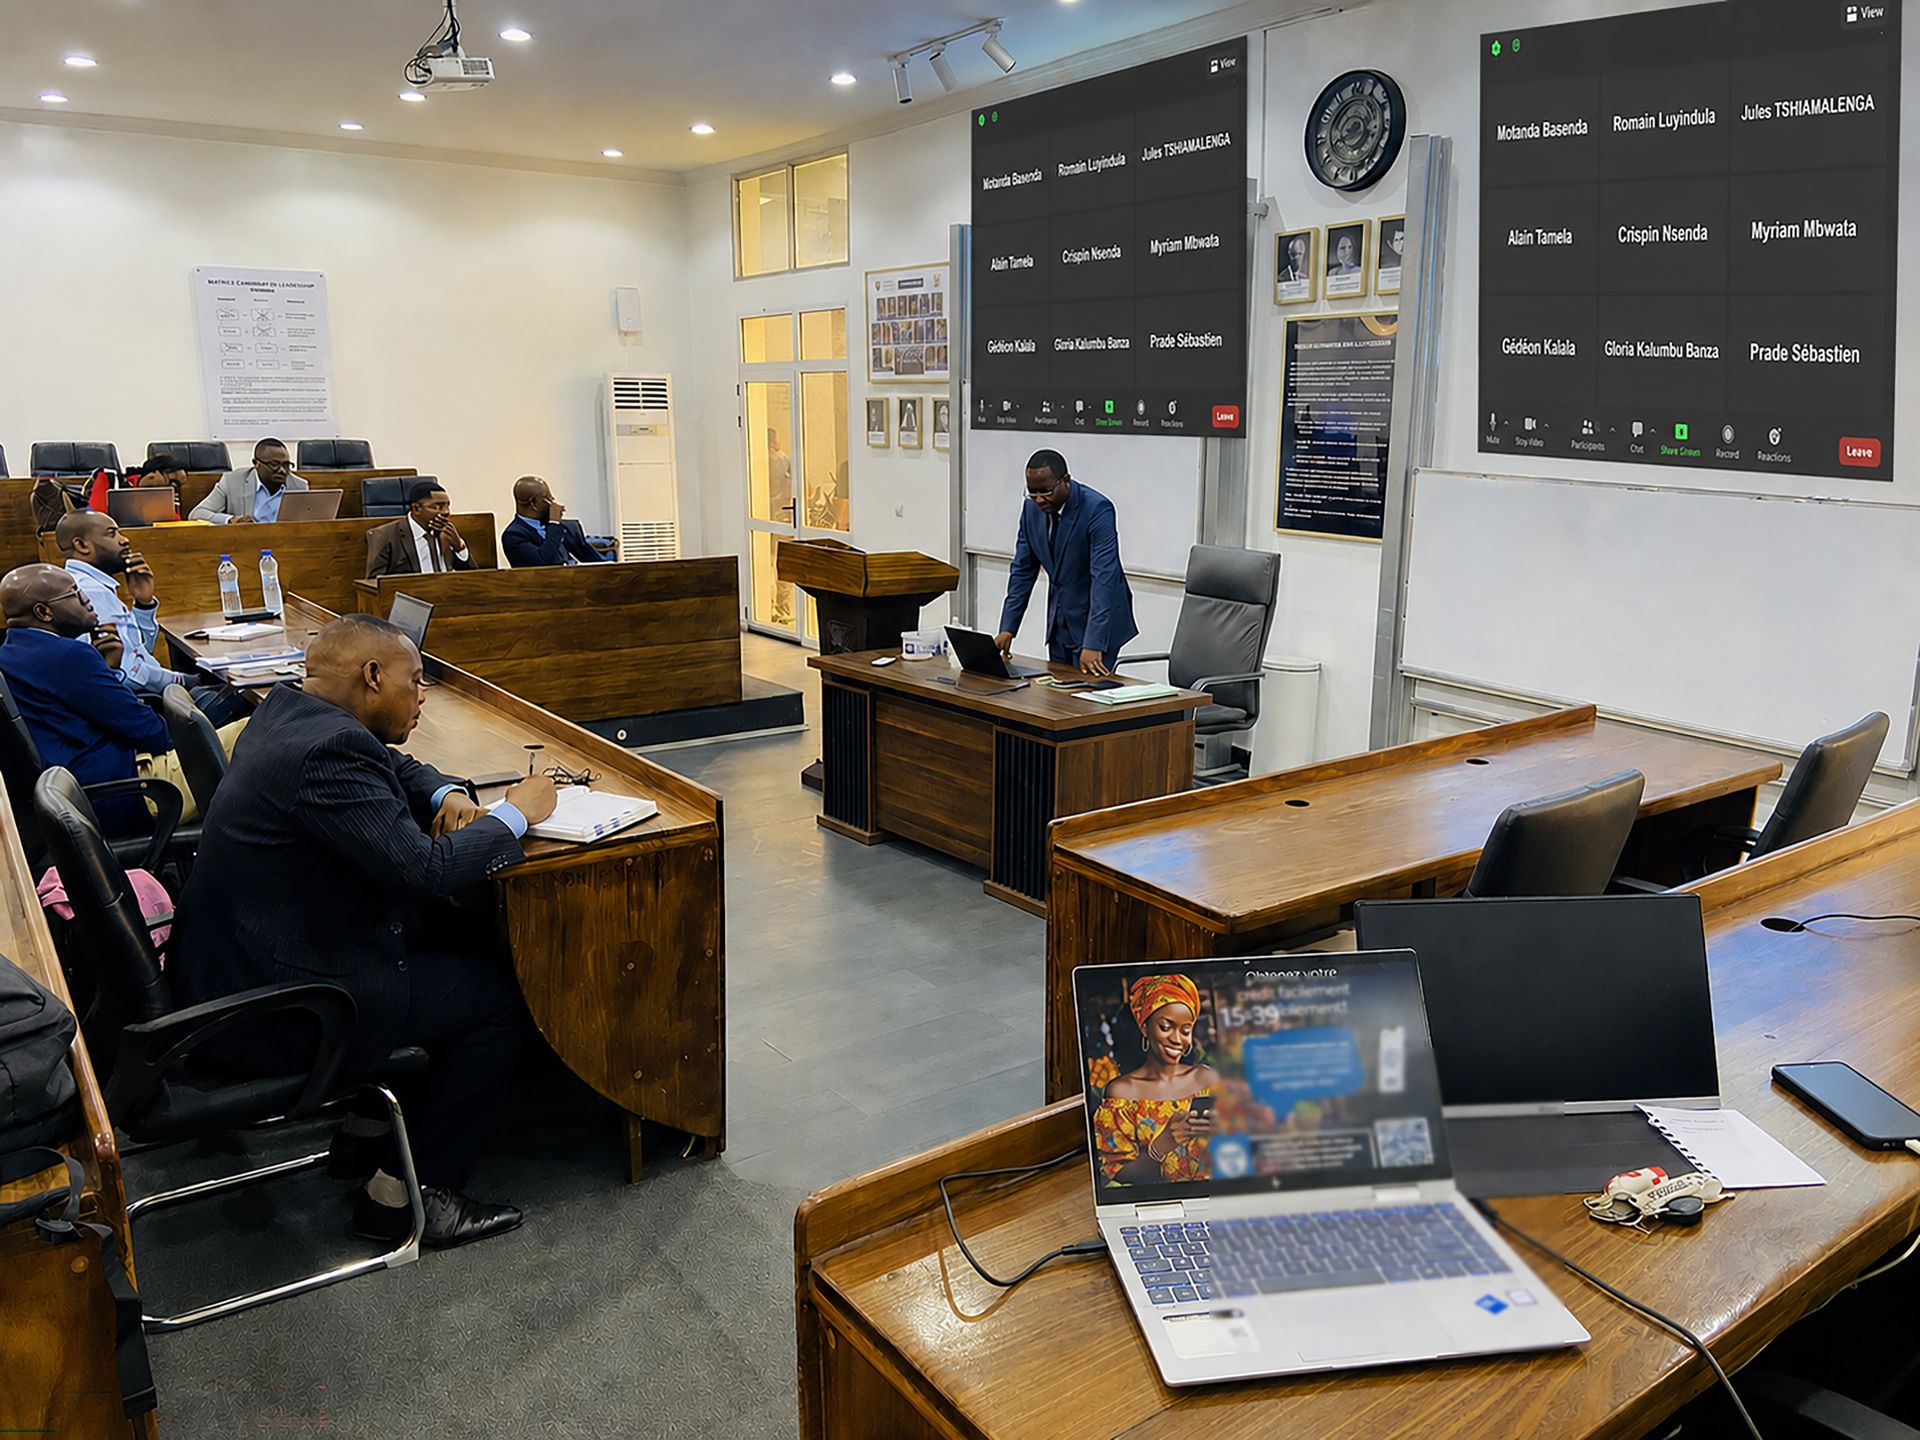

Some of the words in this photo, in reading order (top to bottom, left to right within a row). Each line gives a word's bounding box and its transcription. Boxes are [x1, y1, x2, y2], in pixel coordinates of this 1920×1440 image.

[1860, 6, 1884, 18] View
[1741, 104, 1771, 120] Jules
[1774, 94, 1874, 117] TSHIAMALENGA
[1614, 113, 1655, 131] Romain
[1659, 108, 1715, 131] Luyindula
[1497, 123, 1540, 140] Motanda
[1543, 119, 1588, 137] Basenda
[1142, 147, 1162, 161] Jules
[1058, 160, 1087, 176] Romain
[1508, 229, 1533, 245] Alain
[1535, 228, 1572, 244] Tamela
[1618, 225, 1659, 246] Crispin
[1663, 224, 1708, 241] Nsenda
[1752, 221, 1799, 243] Myriam
[1804, 220, 1856, 237] Mbwata
[1151, 238, 1182, 256] Myriam
[1185, 234, 1219, 250] Mbwata
[1063, 248, 1090, 264] Crispin
[1150, 334, 1175, 348] Prade
[1177, 332, 1222, 347] Sébastien
[1502, 338, 1541, 354] Gédéon
[1544, 339, 1575, 355] Kalala
[1605, 341, 1634, 356] Gloria
[1637, 341, 1683, 357] Kalumbu
[1686, 343, 1719, 358] Banza
[1751, 343, 1788, 361] Prade
[1792, 344, 1859, 363] Sébastien
[1216, 412, 1234, 421] Leave
[1846, 445, 1873, 458] Leave
